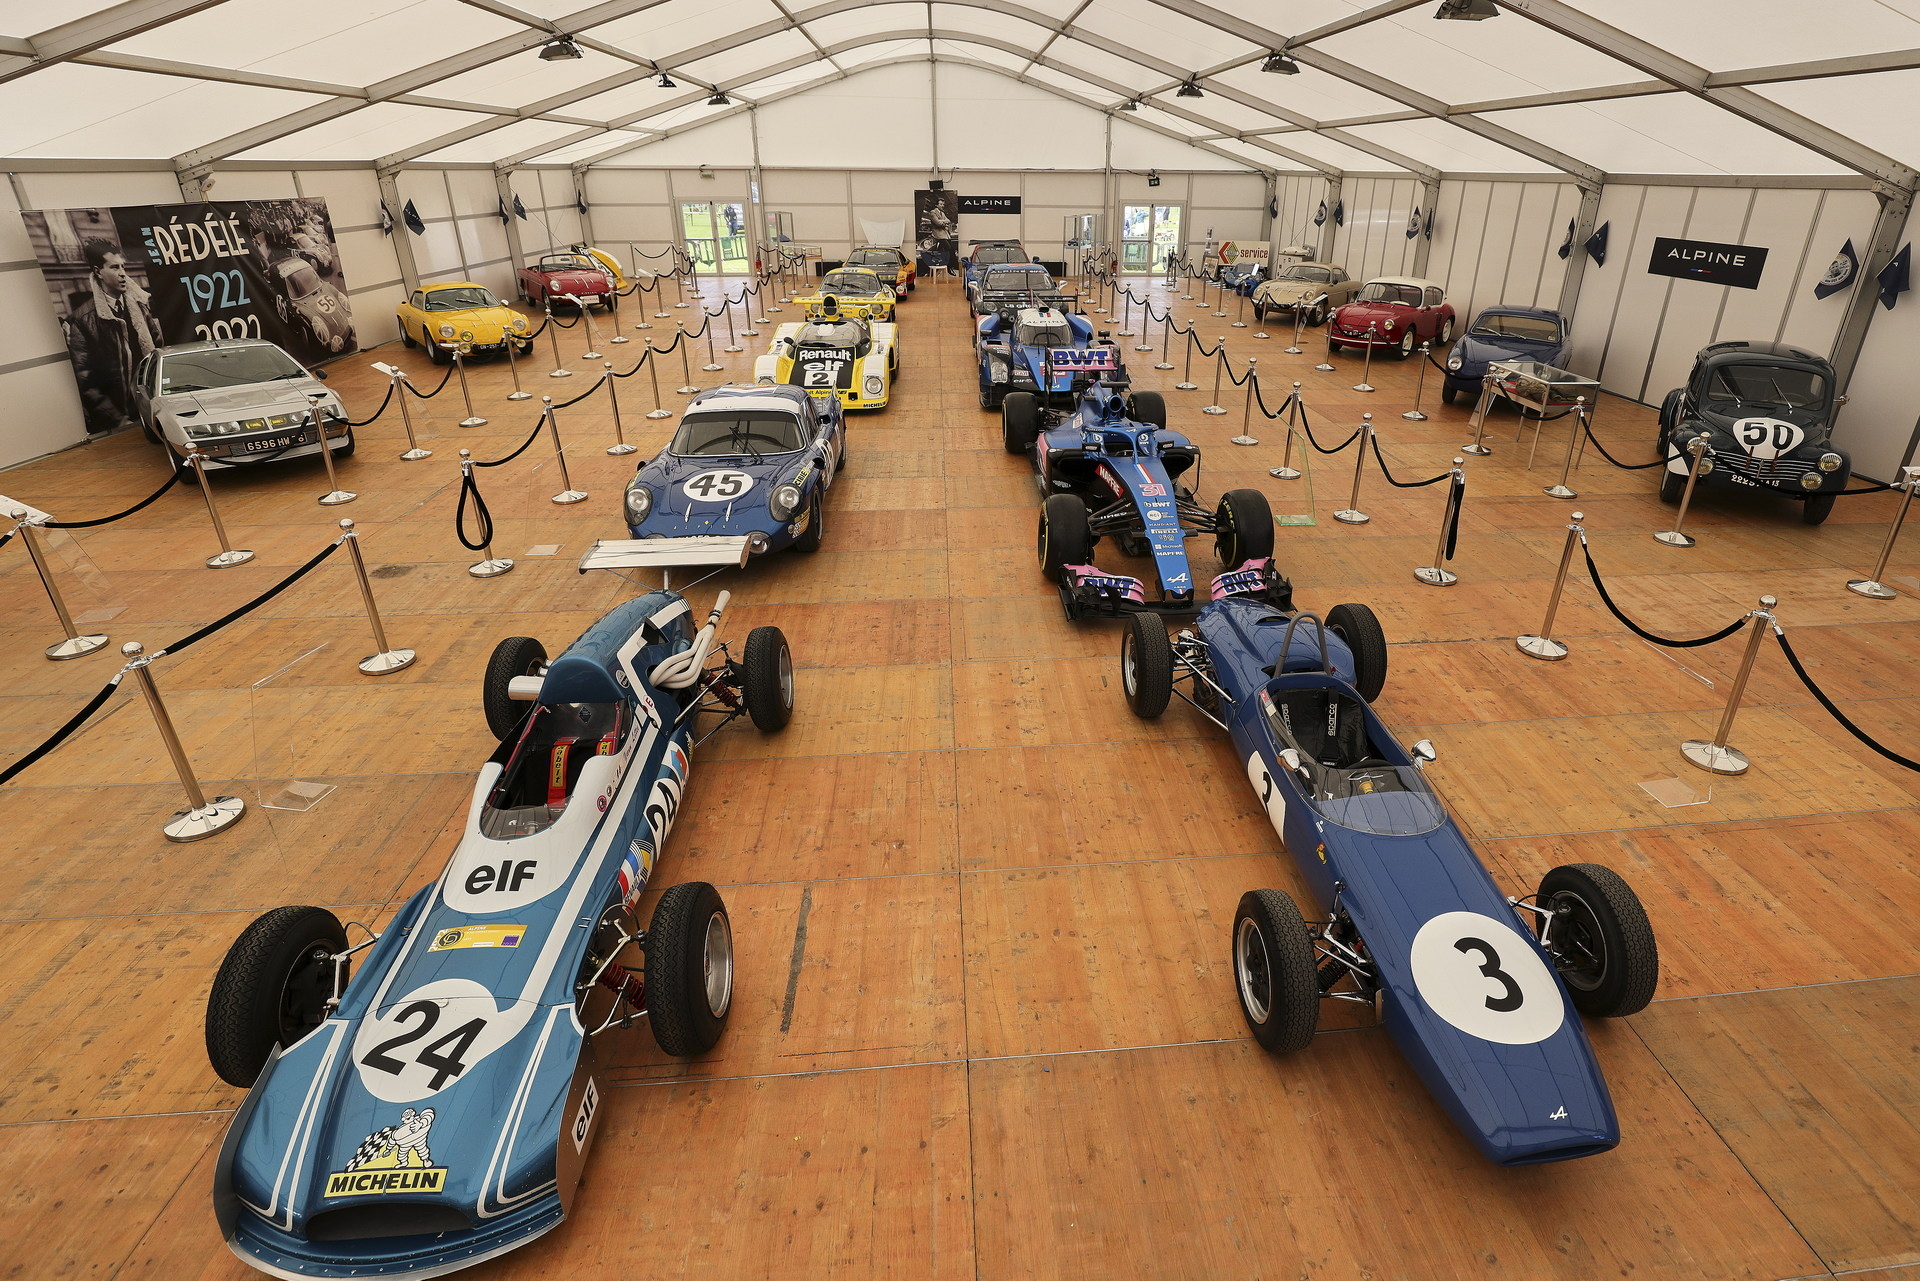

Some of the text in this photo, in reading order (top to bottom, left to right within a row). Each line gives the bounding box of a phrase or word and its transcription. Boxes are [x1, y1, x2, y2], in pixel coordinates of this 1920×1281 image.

[140, 227, 163, 266] JEAN
[153, 211, 250, 266] RÉDÉLÉ
[1240, 247, 1269, 259] service
[1667, 247, 1747, 267] ALPINE
[180, 269, 251, 314] 1922
[317, 295, 336, 313] 56
[799, 349, 852, 362] Renault
[803, 360, 844, 371] elf
[1053, 350, 1109, 366] BWT
[811, 372, 830, 385] 2
[247, 440, 276, 451] 6596
[278, 436, 290, 447] HW
[1742, 421, 1795, 451] 50
[689, 473, 746, 498] 45
[1099, 466, 1121, 498] MAPFRE
[1138, 483, 1168, 497] 31
[1220, 570, 1263, 594] BWT
[1327, 703, 1338, 737] sparco
[464, 859, 538, 896] elf
[1453, 936, 1525, 1014] 3
[361, 1000, 489, 1092] 24
[576, 1083, 594, 1143] elf
[329, 1171, 440, 1194] MICHELIN
